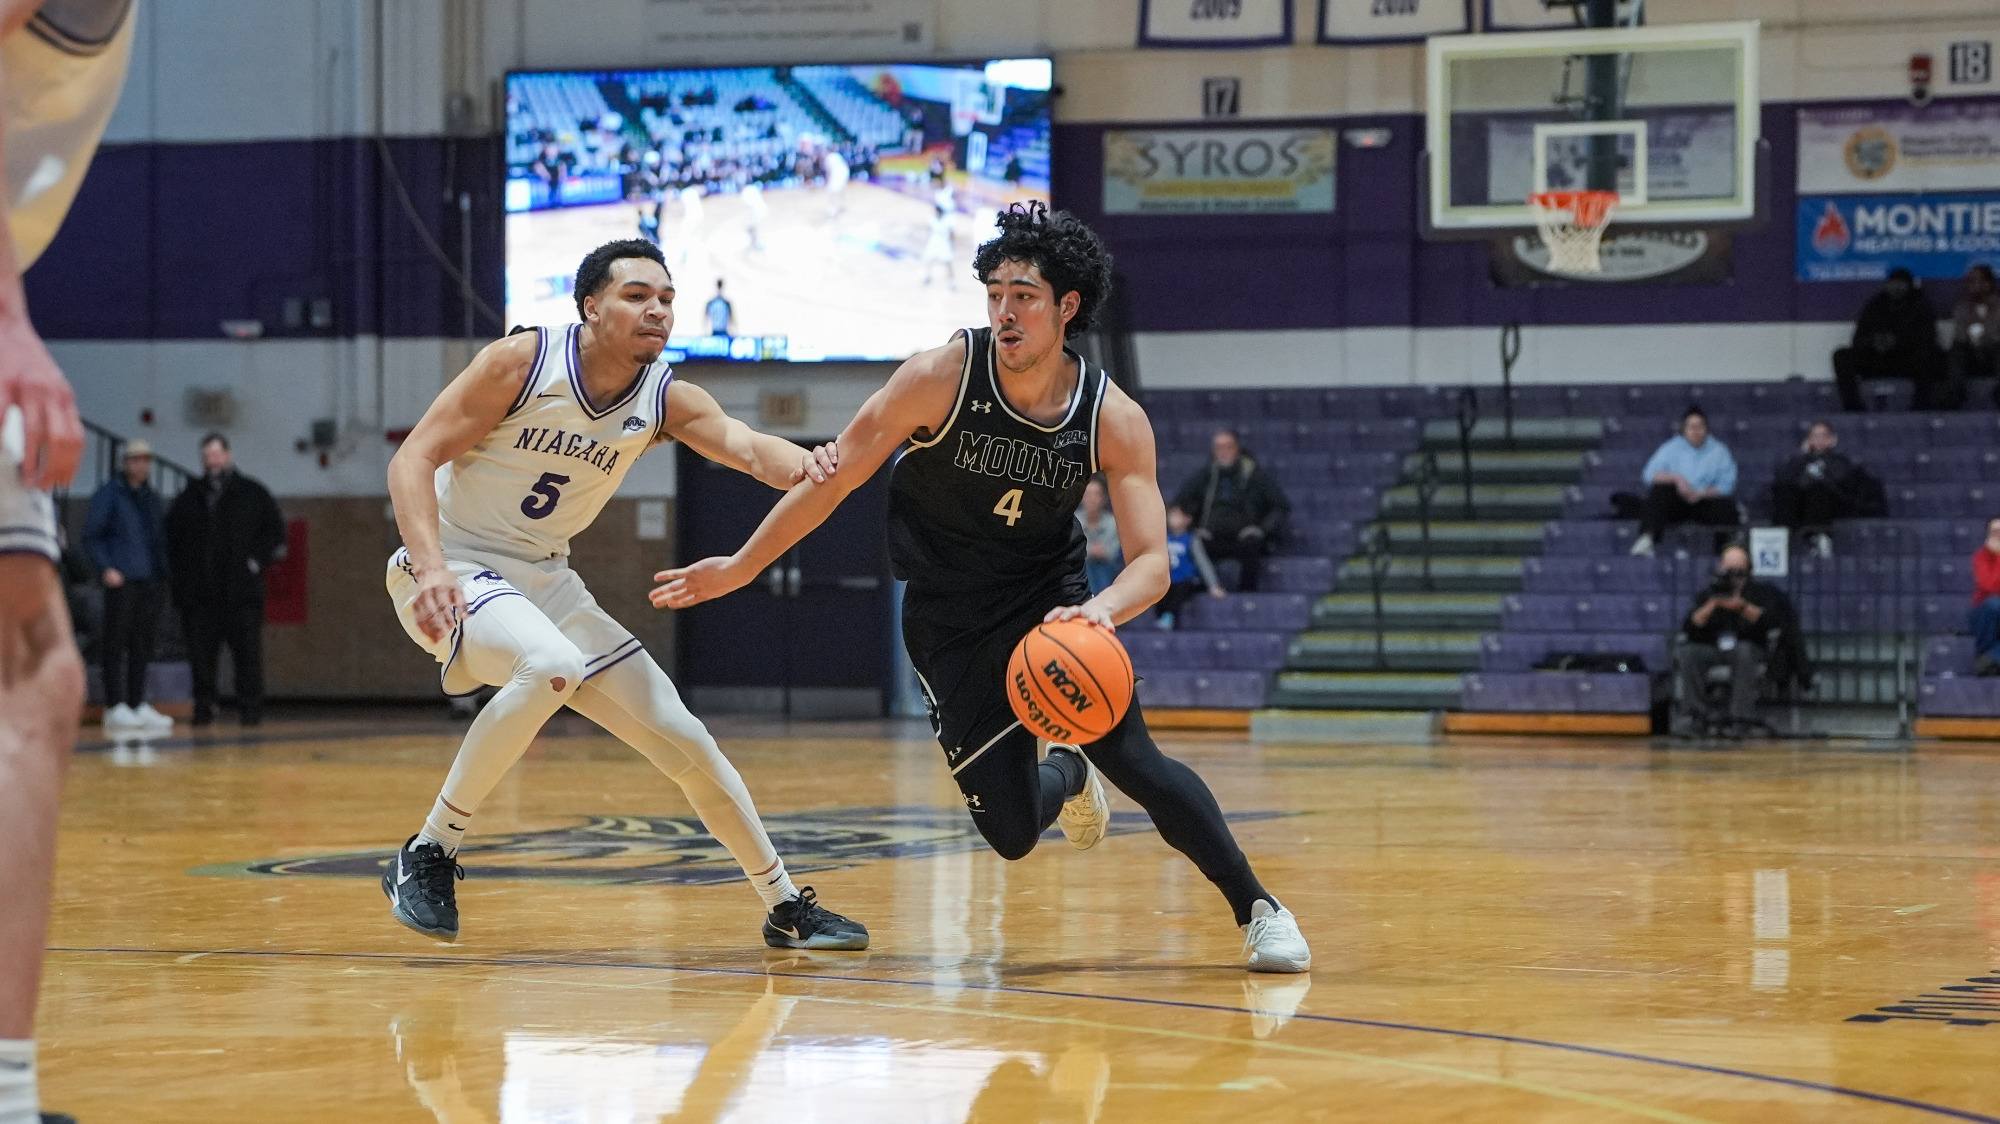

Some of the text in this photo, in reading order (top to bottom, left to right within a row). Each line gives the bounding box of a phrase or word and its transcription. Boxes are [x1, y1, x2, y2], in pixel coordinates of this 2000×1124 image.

[1954, 44, 1985, 81] 18
[1208, 80, 1237, 115] 17
[1138, 136, 1298, 178] SYROS
[513, 428, 620, 475] NIAGARA
[954, 431, 1083, 489] MOUNT
[1054, 430, 1088, 449] MAAC
[521, 472, 571, 520] 5
[993, 489, 1024, 526] 4
[1015, 670, 1072, 741] Wilson
[1043, 658, 1093, 713] NCAA
